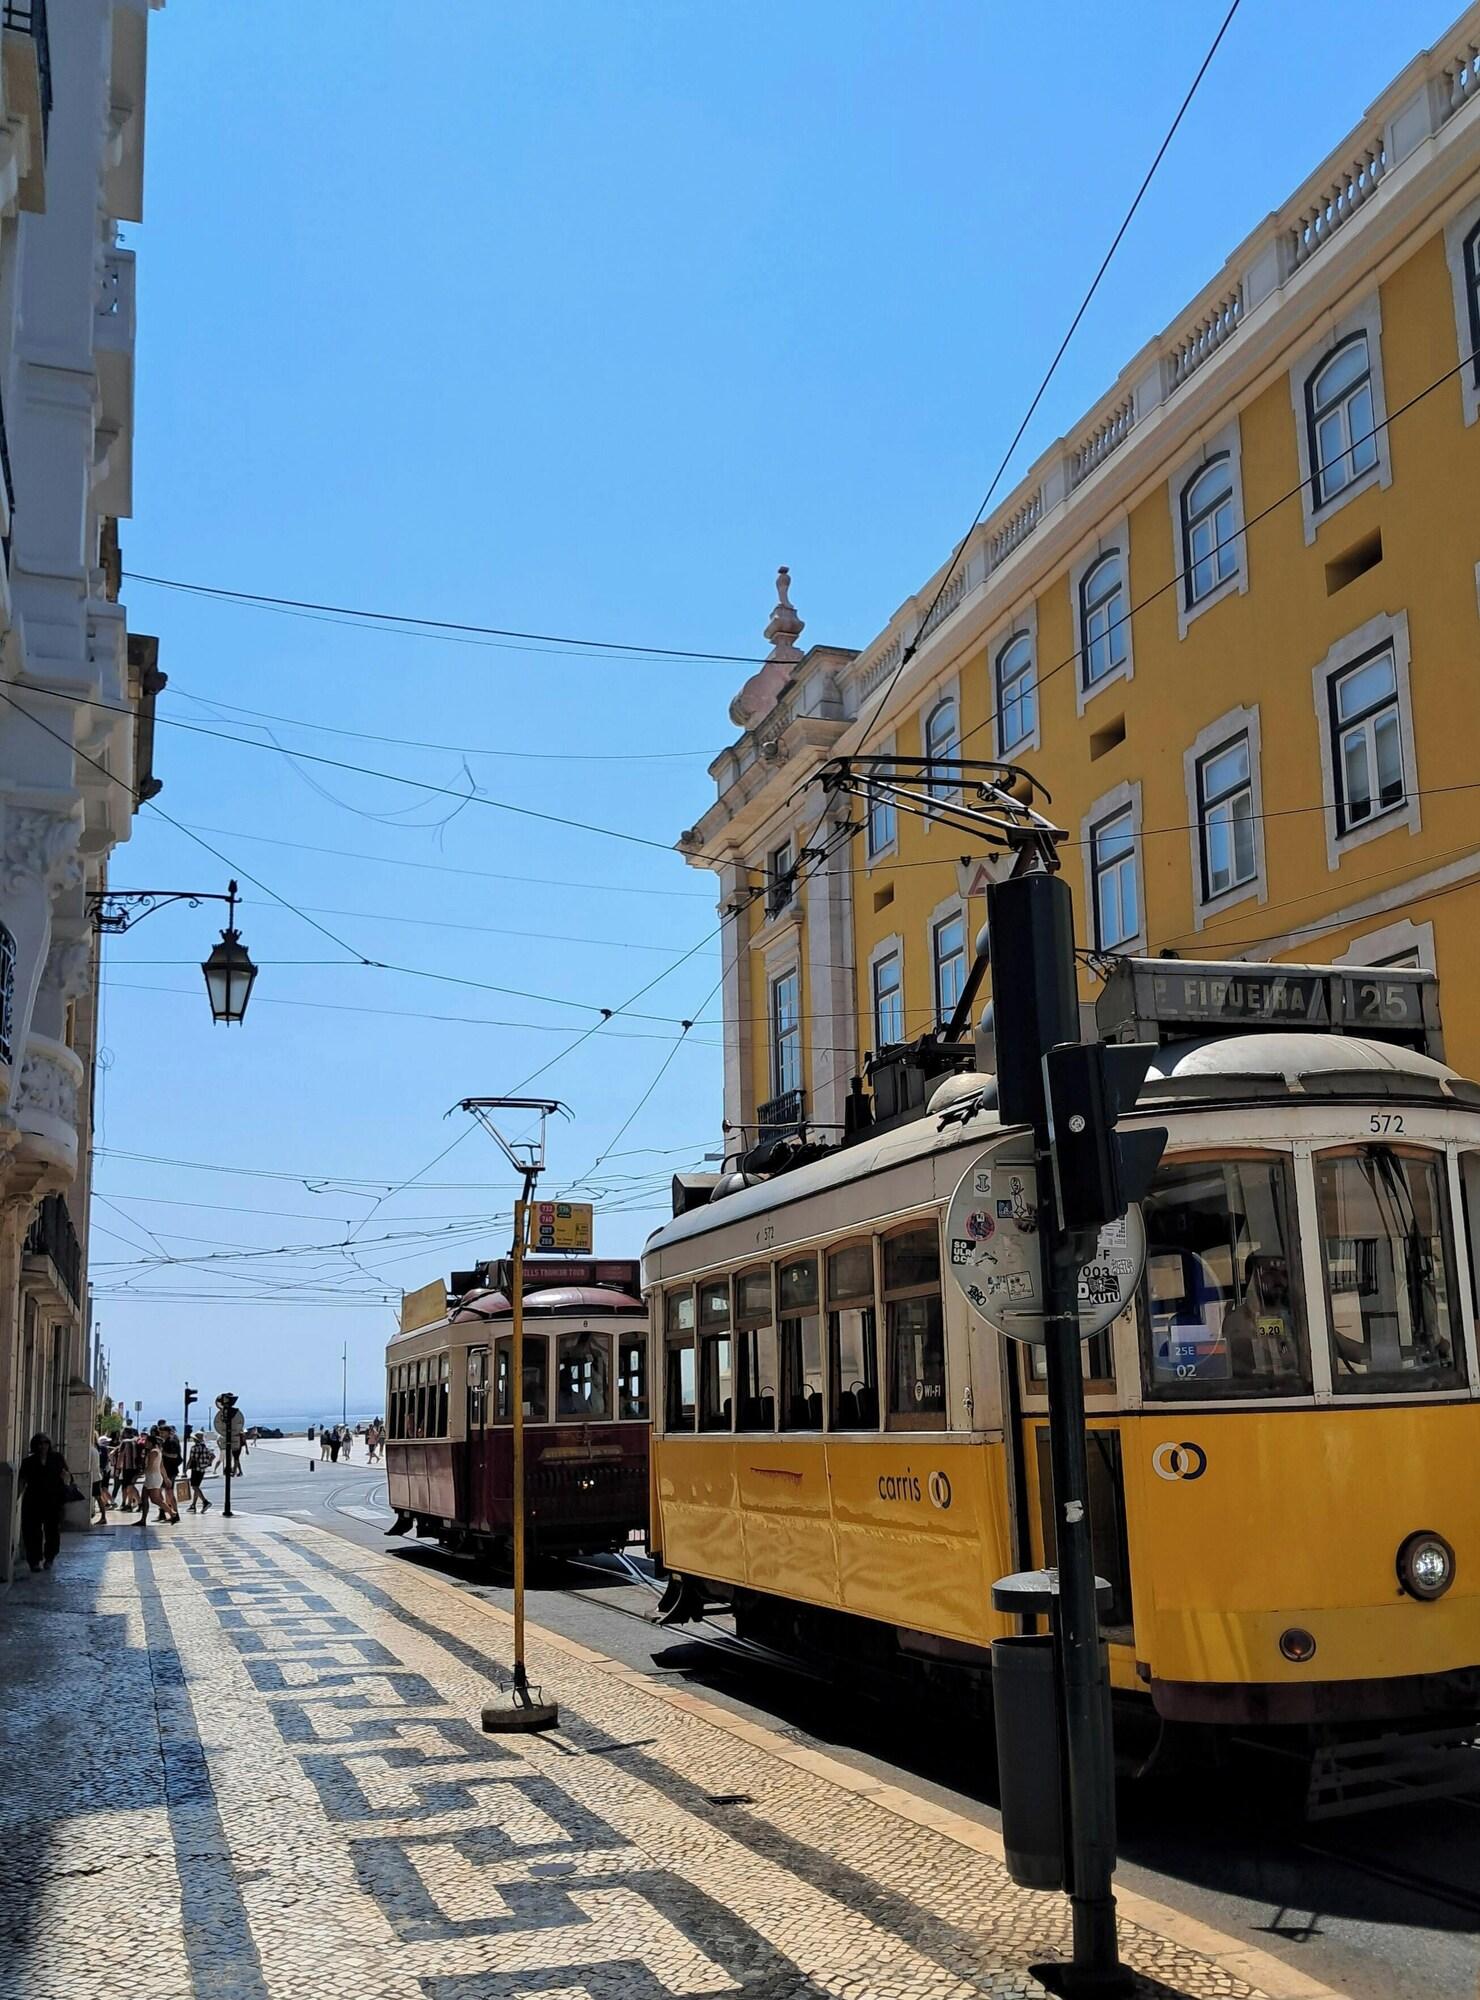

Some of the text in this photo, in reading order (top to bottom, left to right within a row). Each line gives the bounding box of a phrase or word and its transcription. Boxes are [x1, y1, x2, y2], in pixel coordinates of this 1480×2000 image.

[1183, 979, 1306, 1011] FIGUEIRA
[1360, 984, 1408, 1021] 25
[1370, 1114, 1405, 1133] 572
[764, 1225, 775, 1241] 572
[953, 1240, 967, 1249] SO
[1082, 1265, 1110, 1278] 003
[1089, 1291, 1121, 1305] KUTU
[1259, 1325, 1280, 1336] 3.20
[1175, 1346, 1196, 1356] 25E
[1176, 1364, 1197, 1378] 02
[924, 1384, 941, 1398] WI-FI
[878, 1466, 922, 1502] carris
